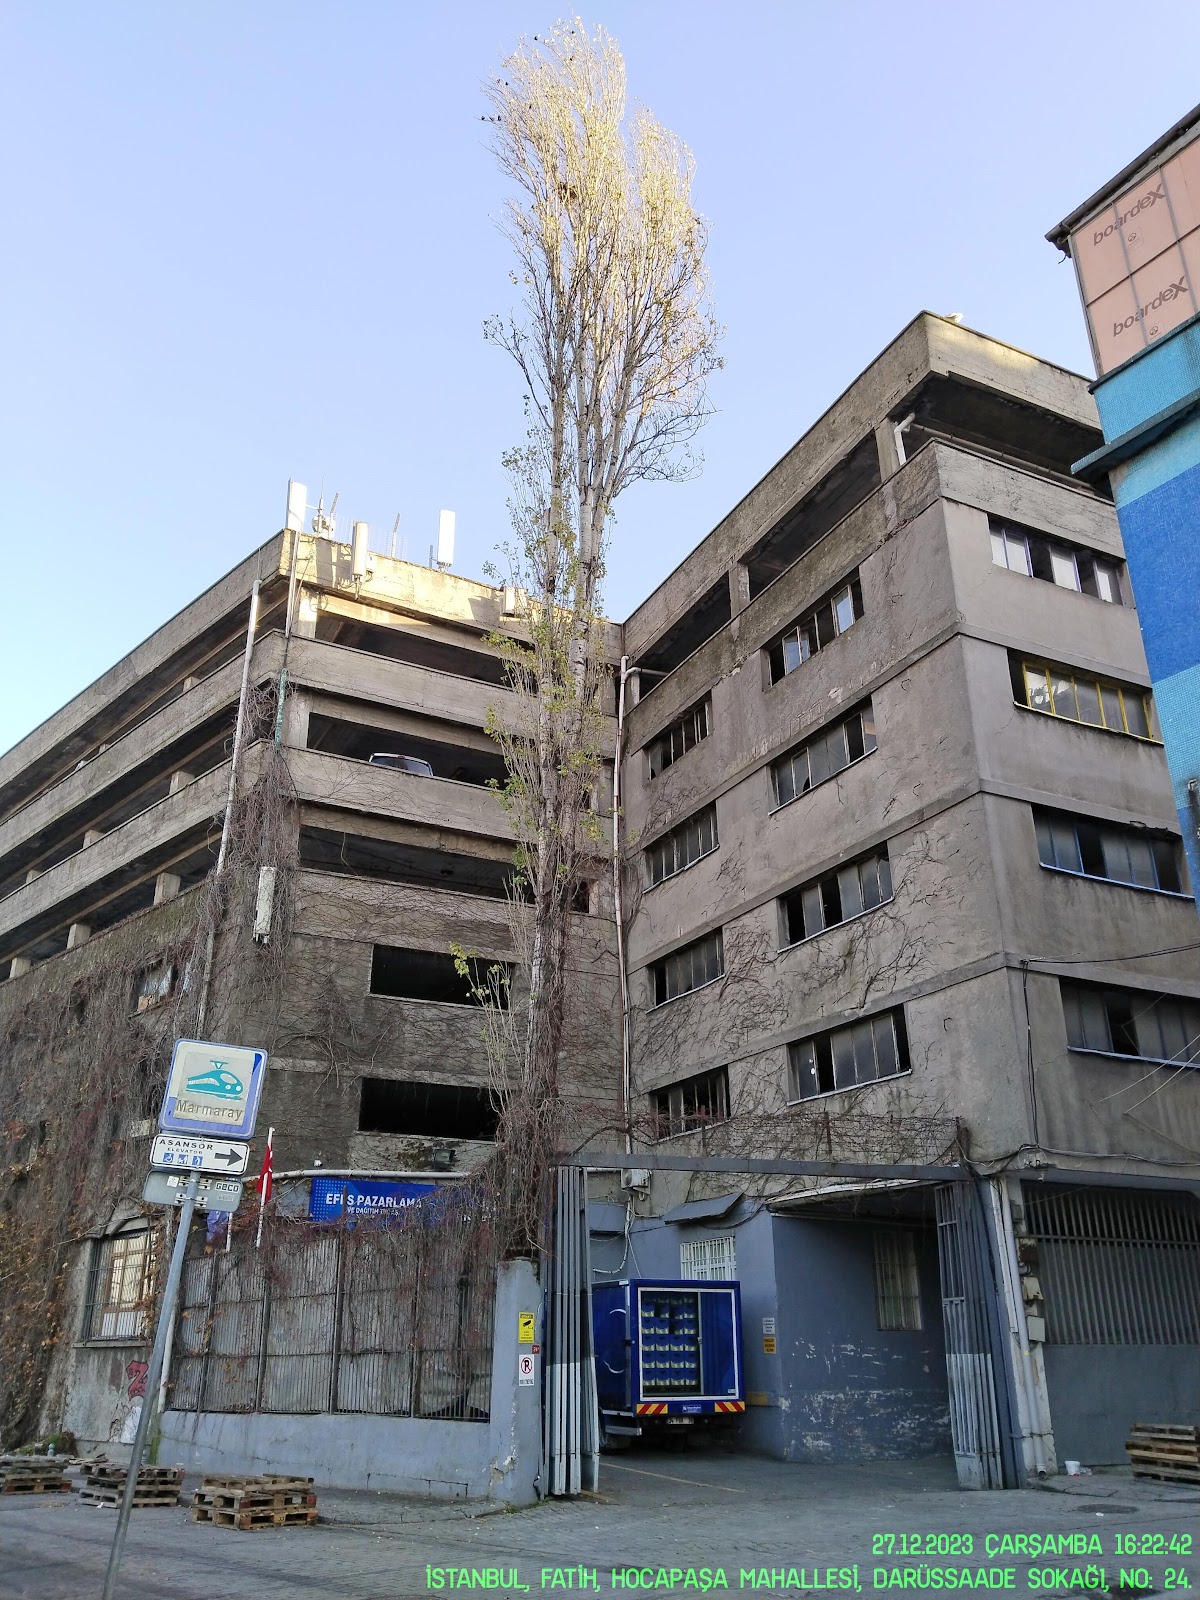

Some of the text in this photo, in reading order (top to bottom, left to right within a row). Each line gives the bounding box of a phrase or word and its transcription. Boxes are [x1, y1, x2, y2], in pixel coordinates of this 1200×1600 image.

[1093, 183, 1165, 246] boardex
[1113, 275, 1189, 337] boardex
[175, 1100, 243, 1122] Marmaray
